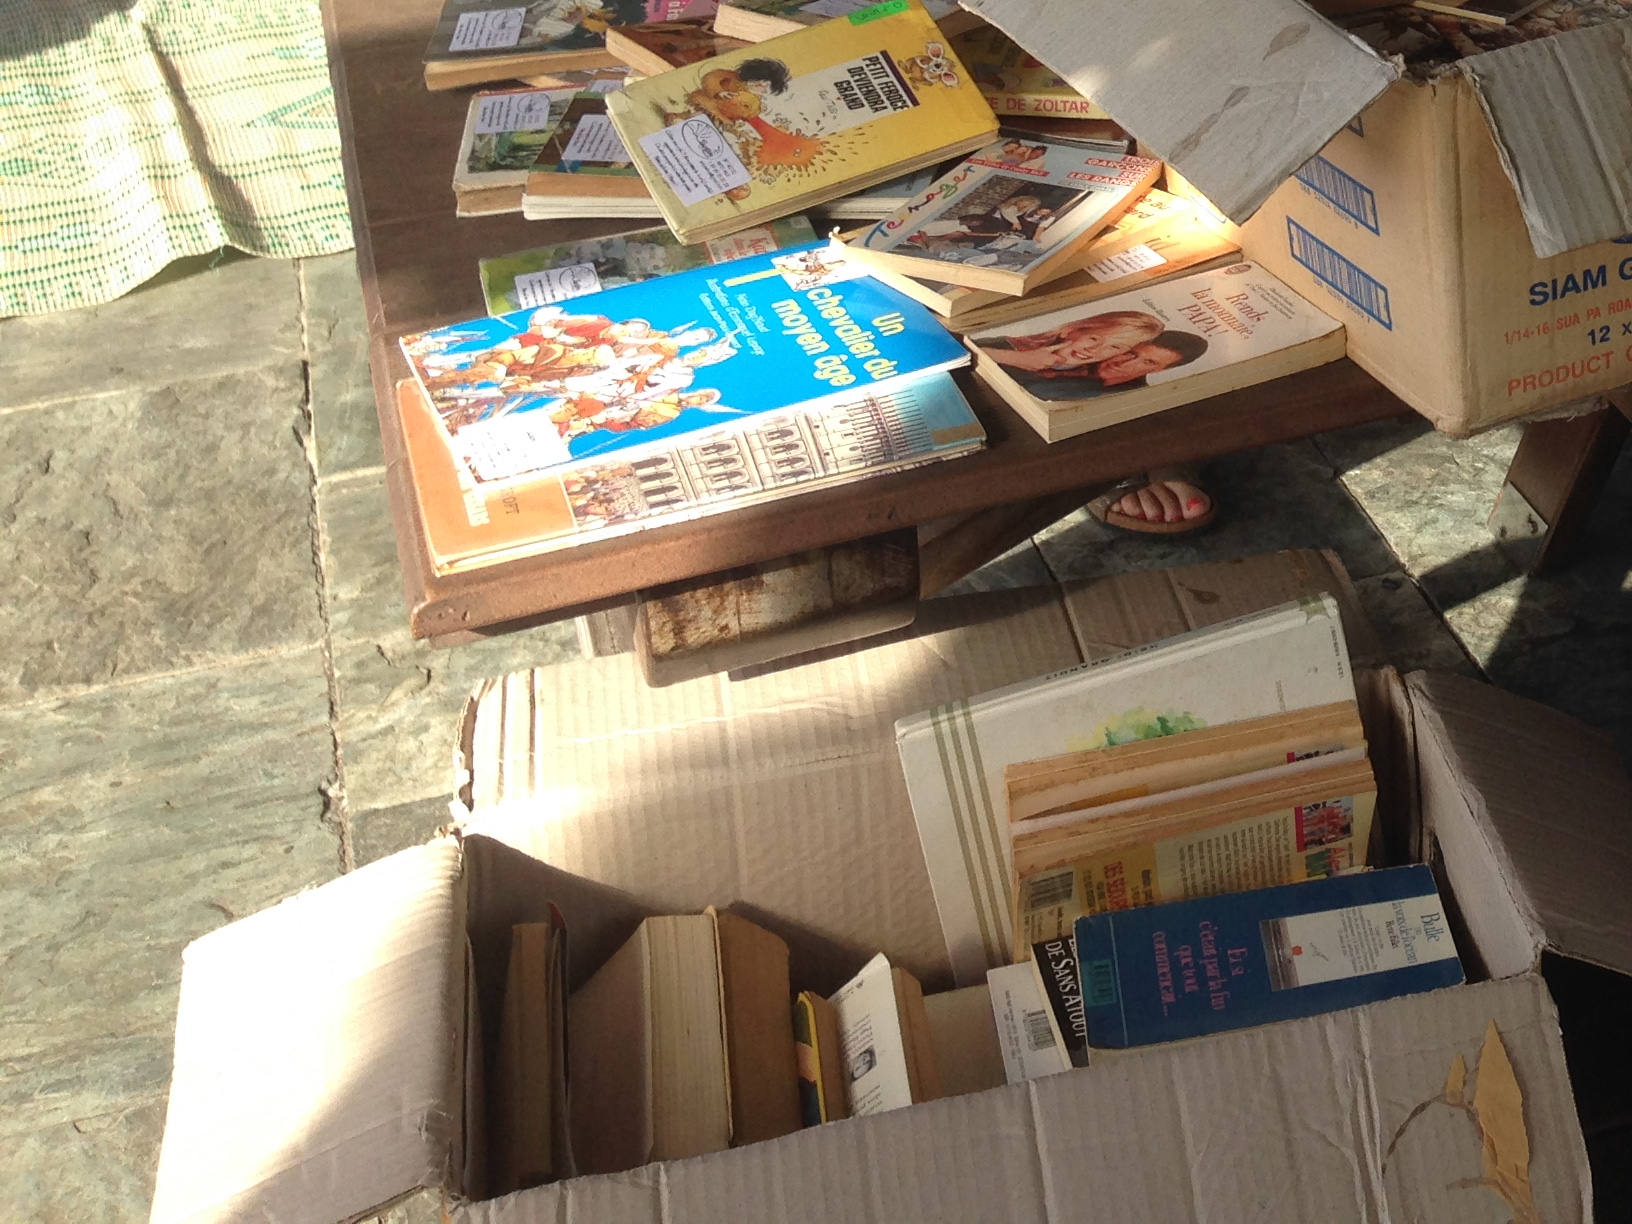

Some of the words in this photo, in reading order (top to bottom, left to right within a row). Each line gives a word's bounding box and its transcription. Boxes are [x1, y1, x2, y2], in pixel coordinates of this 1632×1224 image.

[862, 55, 890, 80] PETIT
[833, 79, 865, 110] GRAND
[847, 65, 887, 113] DEVIENDRA
[1006, 98, 1025, 111] DE
[1035, 99, 1089, 113] ZOLTAR
[1528, 266, 1607, 307] SIAM
[1224, 292, 1267, 322] Rends
[806, 289, 880, 357] chevalier
[862, 358, 898, 379] du
[871, 312, 904, 336] Un
[1503, 319, 1549, 345] 1/14-16
[1556, 313, 1580, 333] SUA
[1586, 306, 1601, 321] PA
[1587, 325, 1610, 347] 12
[771, 299, 829, 355] moyen
[813, 354, 856, 386] âge
[1507, 350, 1615, 397] PRODUCT
[1420, 912, 1441, 943] Bulle
[1045, 940, 1060, 960] DE
[1175, 944, 1193, 968] que
[1227, 947, 1248, 963] Et
[1181, 967, 1199, 993] tout
[1231, 965, 1250, 976] si
[1210, 991, 1231, 1011] fin
